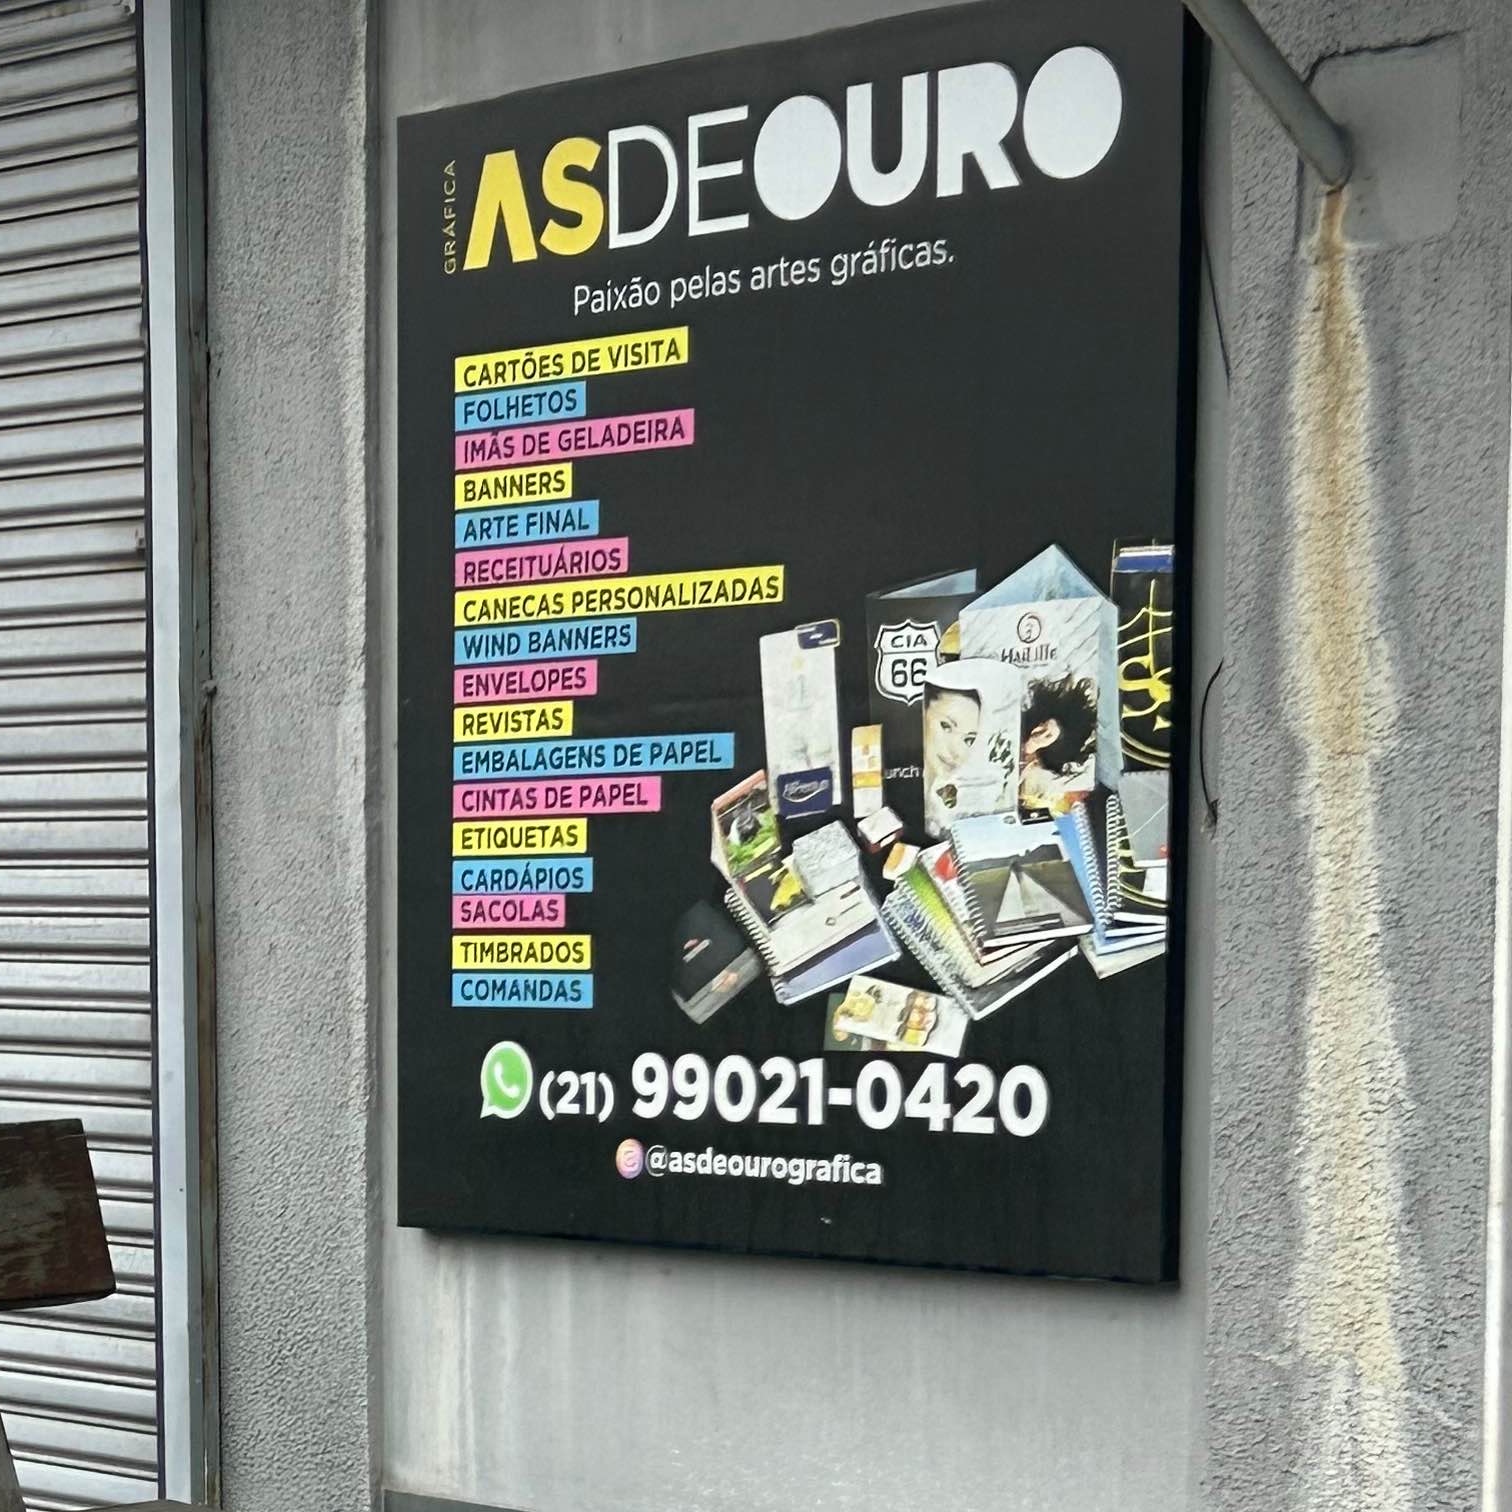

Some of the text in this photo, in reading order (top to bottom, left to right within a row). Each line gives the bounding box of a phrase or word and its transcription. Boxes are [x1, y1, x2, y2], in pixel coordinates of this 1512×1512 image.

[574, 237, 956, 316] Paixão pelas artes gráficas.
[463, 337, 681, 388] CARTÕES DE VISITA
[463, 388, 578, 425] FOLHETOS
[463, 416, 686, 464] IMÃS DE GELADEIRA
[463, 469, 566, 502] BANNERS
[463, 507, 590, 543] ARTE FINAL
[463, 545, 622, 584] RECEITUÁRIOS
[462, 574, 781, 623] CANECAS PERSONALIZADAS
[462, 623, 632, 659] WIND BANNERS
[891, 634, 928, 649] CIA
[462, 666, 587, 698] ENVELOPES
[462, 706, 564, 737] REVISTAS
[461, 739, 723, 775] EMBALAGENS DE PAPEL
[461, 781, 649, 813] CINTAS DE PAPEL
[461, 824, 579, 851] ETIQUETAS
[460, 861, 585, 893] CARDÁPIOS
[460, 899, 560, 923] SACOLAS
[460, 941, 585, 965] TIMBRADOS
[460, 978, 583, 1003] COMANDAS
[539, 1051, 1050, 1138] (21) 99021-0420
[646, 1144, 884, 1185] @asdeourografica
